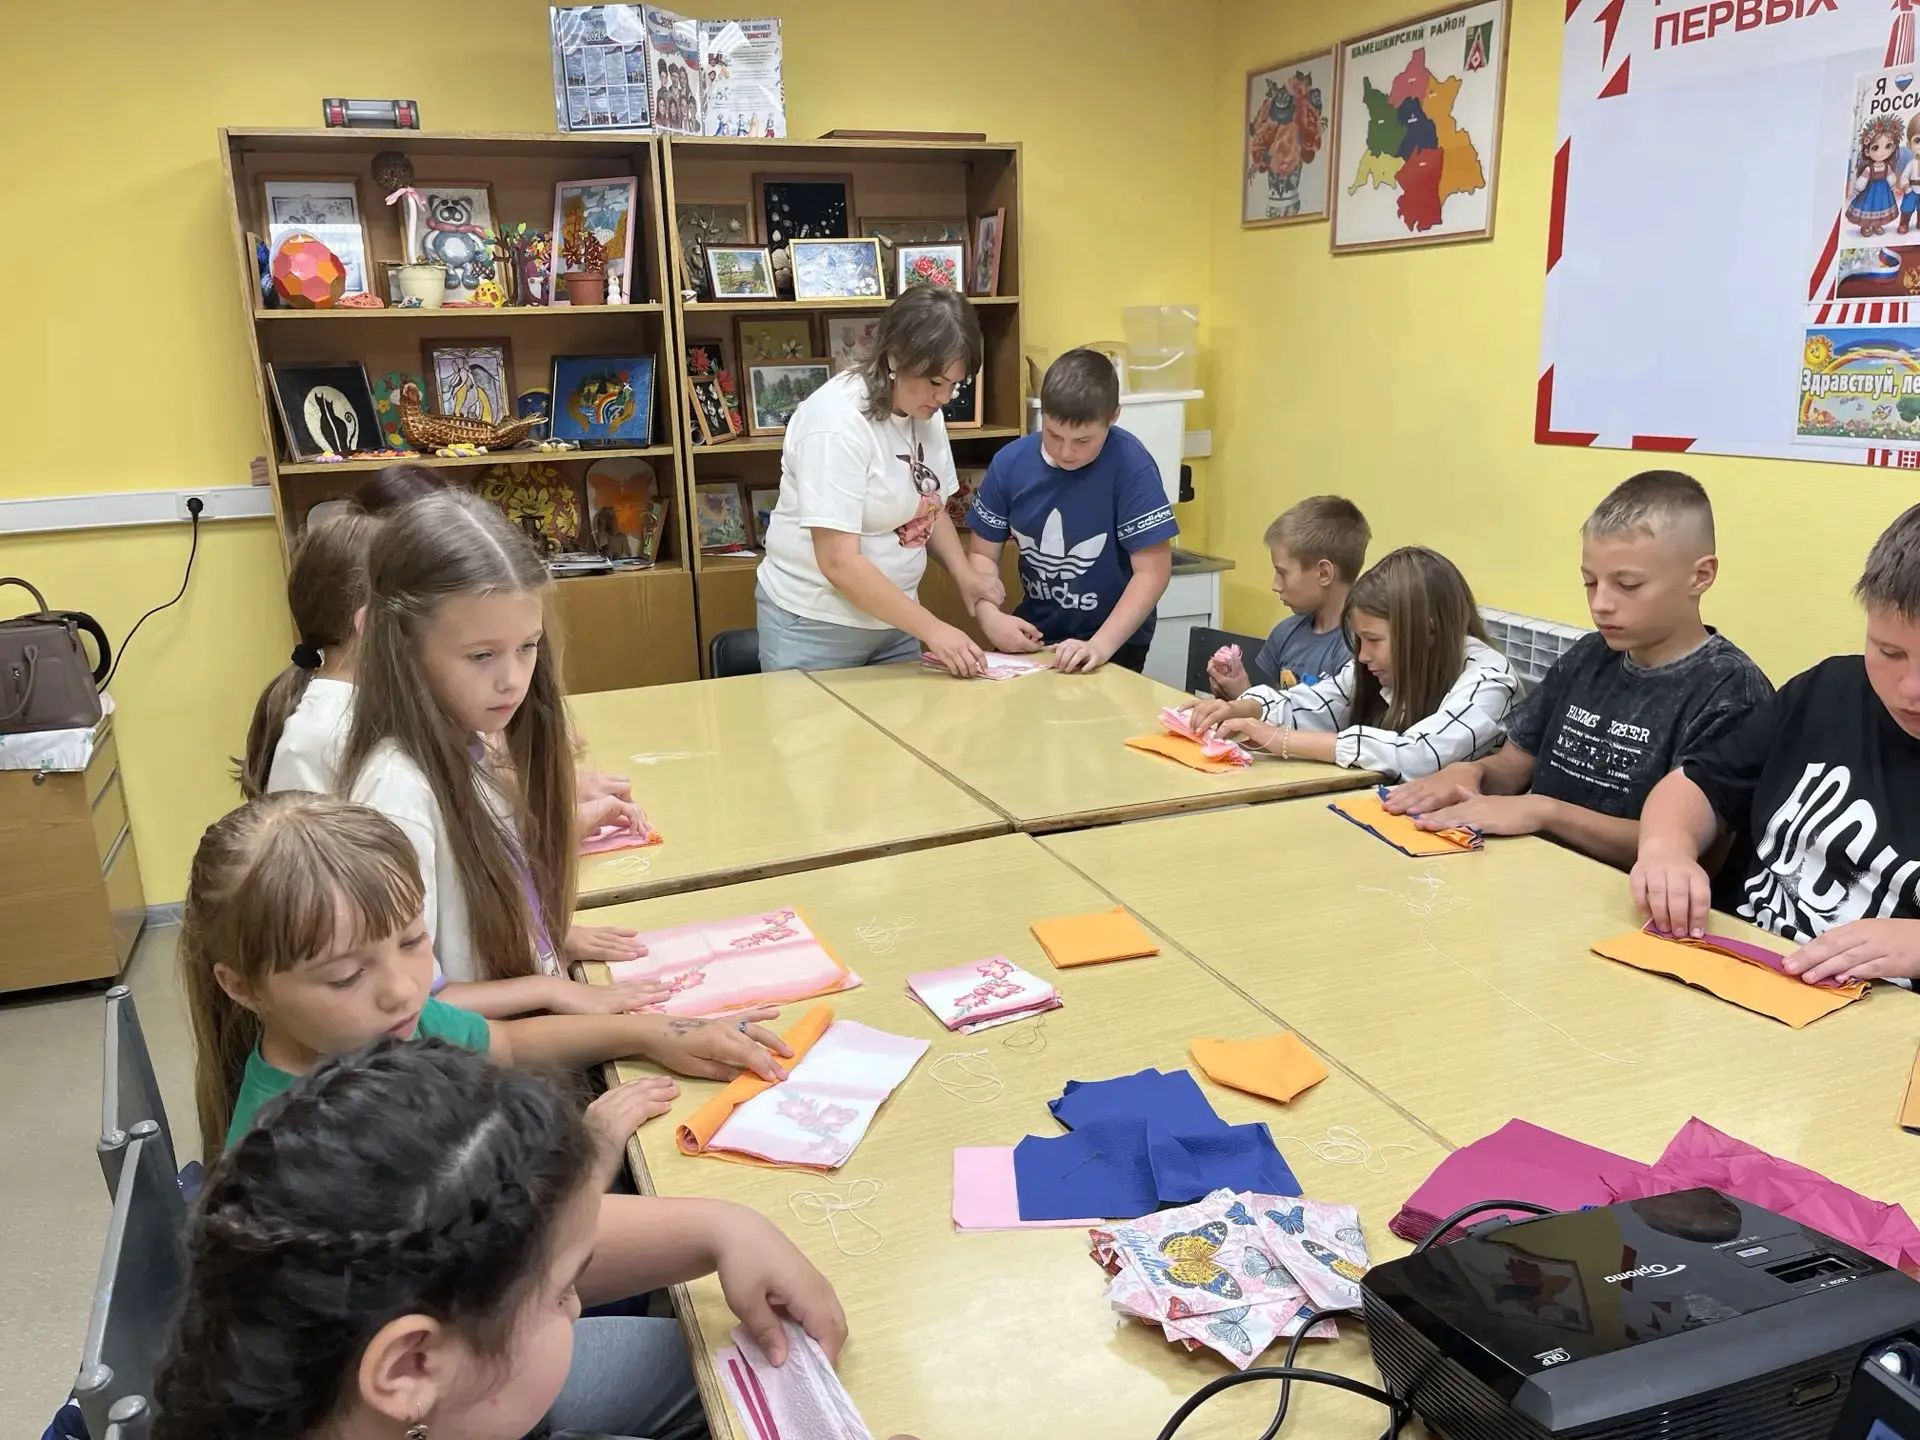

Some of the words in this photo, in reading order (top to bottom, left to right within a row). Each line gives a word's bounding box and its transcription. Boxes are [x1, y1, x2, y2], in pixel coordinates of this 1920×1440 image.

[1429, 15, 1466, 37] РАЙОН
[1874, 77, 1887, 96] Я
[1801, 367, 1898, 400] Здравствуй,
[1137, 509, 1172, 529] adidas
[1021, 573, 1099, 611] adidas
[1756, 762, 1920, 919] FOCU
[1603, 1263, 1668, 1283] Optoma
